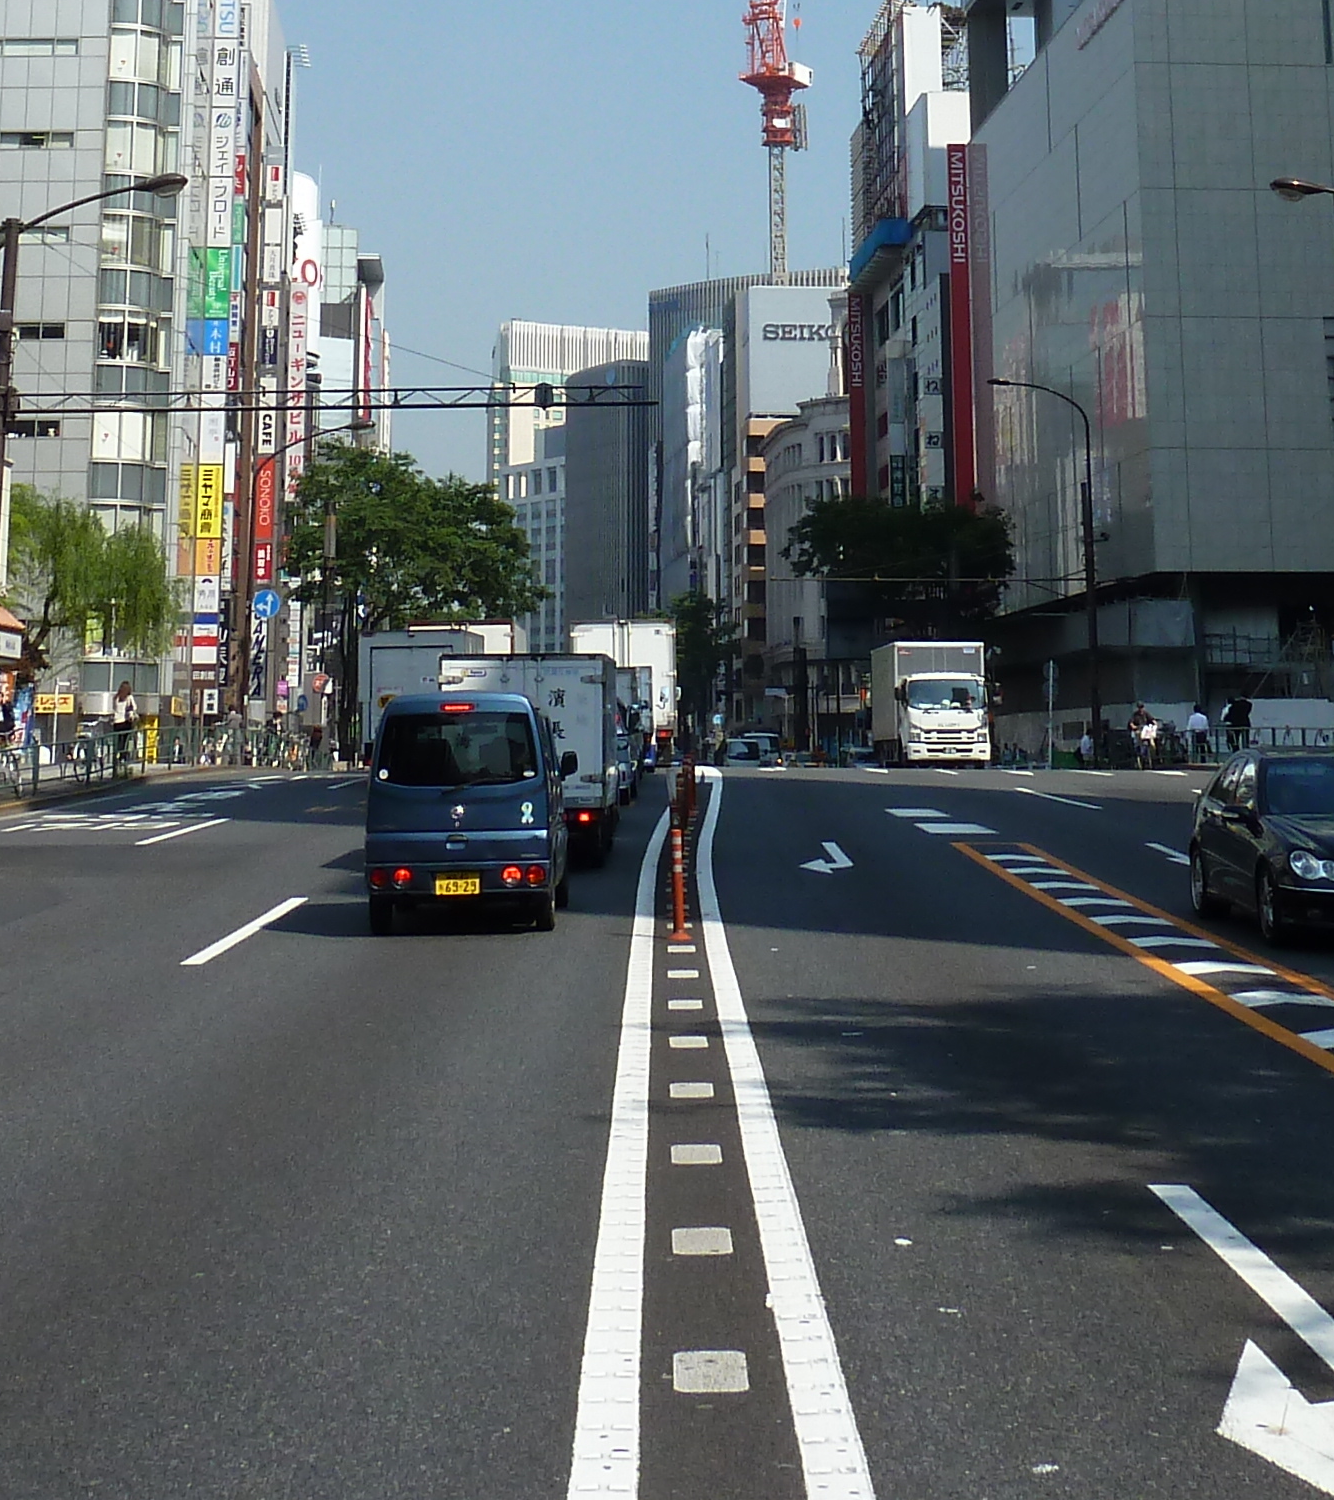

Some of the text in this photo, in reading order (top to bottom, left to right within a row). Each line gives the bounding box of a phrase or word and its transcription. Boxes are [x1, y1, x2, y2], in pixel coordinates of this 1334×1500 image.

[214, 47, 236, 97] 創通
[950, 151, 968, 264] MITSUKOSHI
[849, 297, 864, 388] MITSUKOSHI
[261, 413, 273, 446] CAFE
[258, 469, 272, 526] SONOKO
